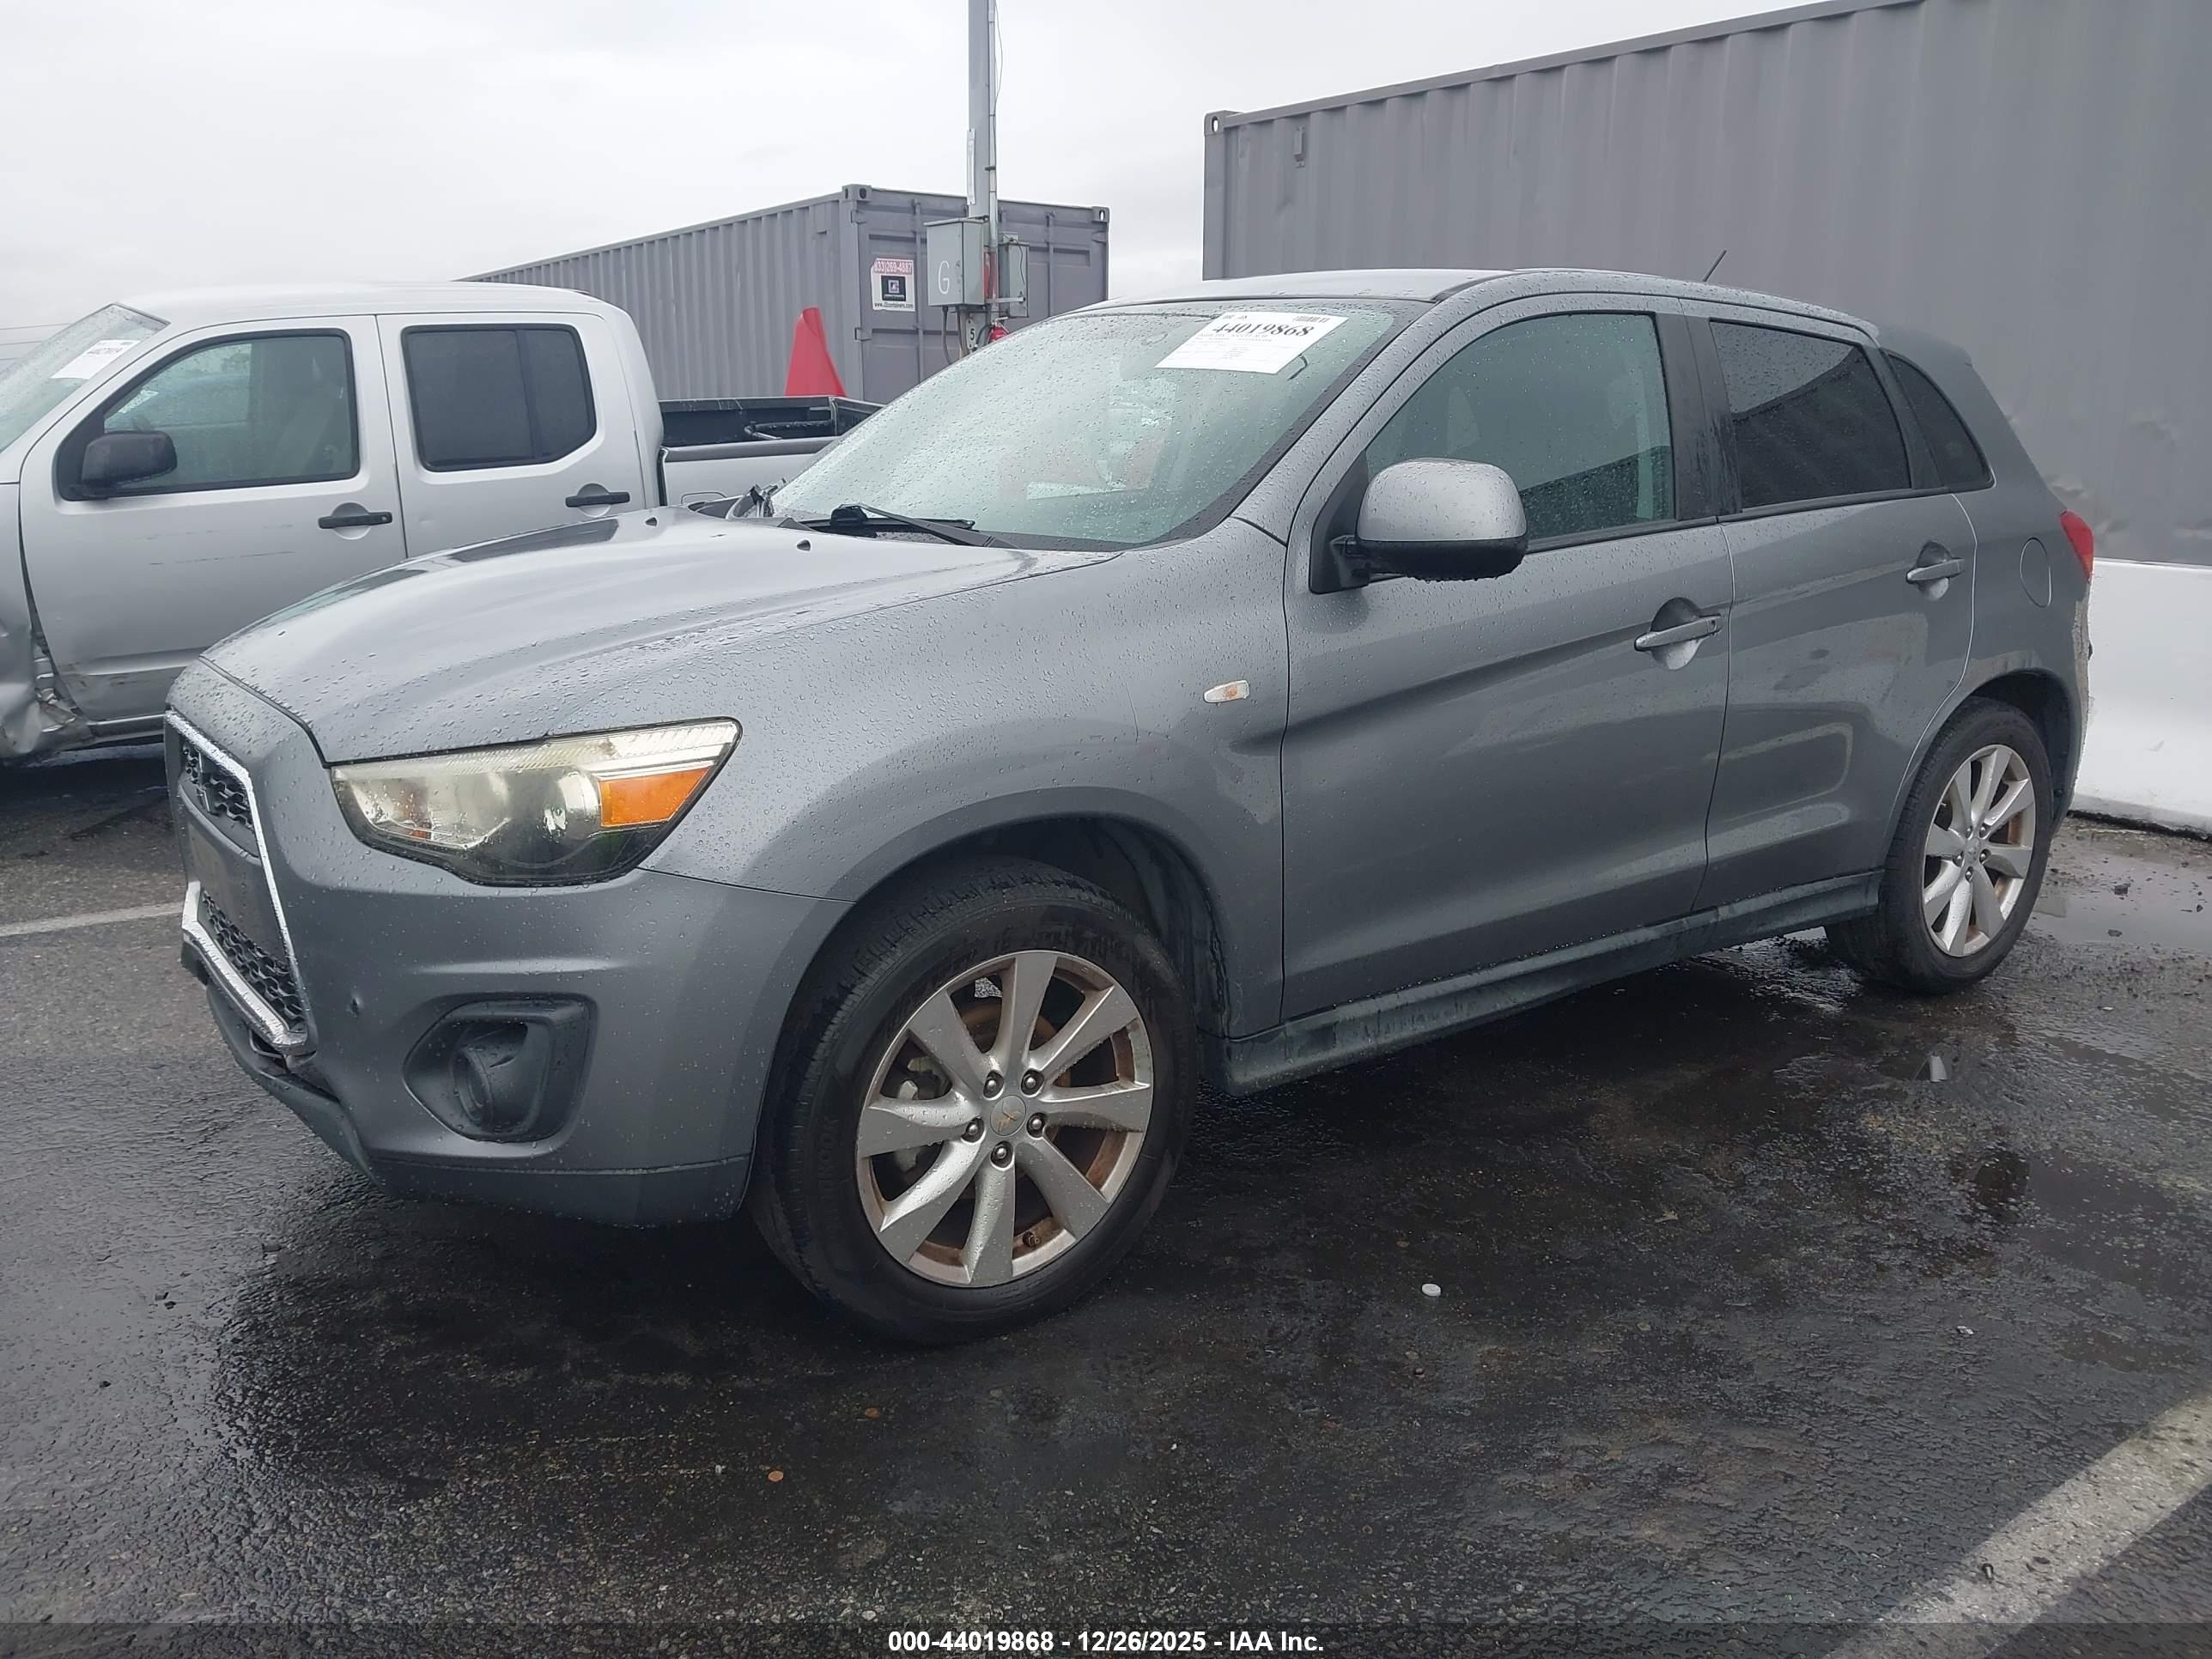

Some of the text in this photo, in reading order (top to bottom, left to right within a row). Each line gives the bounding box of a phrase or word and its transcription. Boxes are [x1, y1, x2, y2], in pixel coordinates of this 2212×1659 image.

[938, 260, 950, 295] G
[969, 328, 975, 341] 5
[1212, 323, 1315, 336] 44019868
